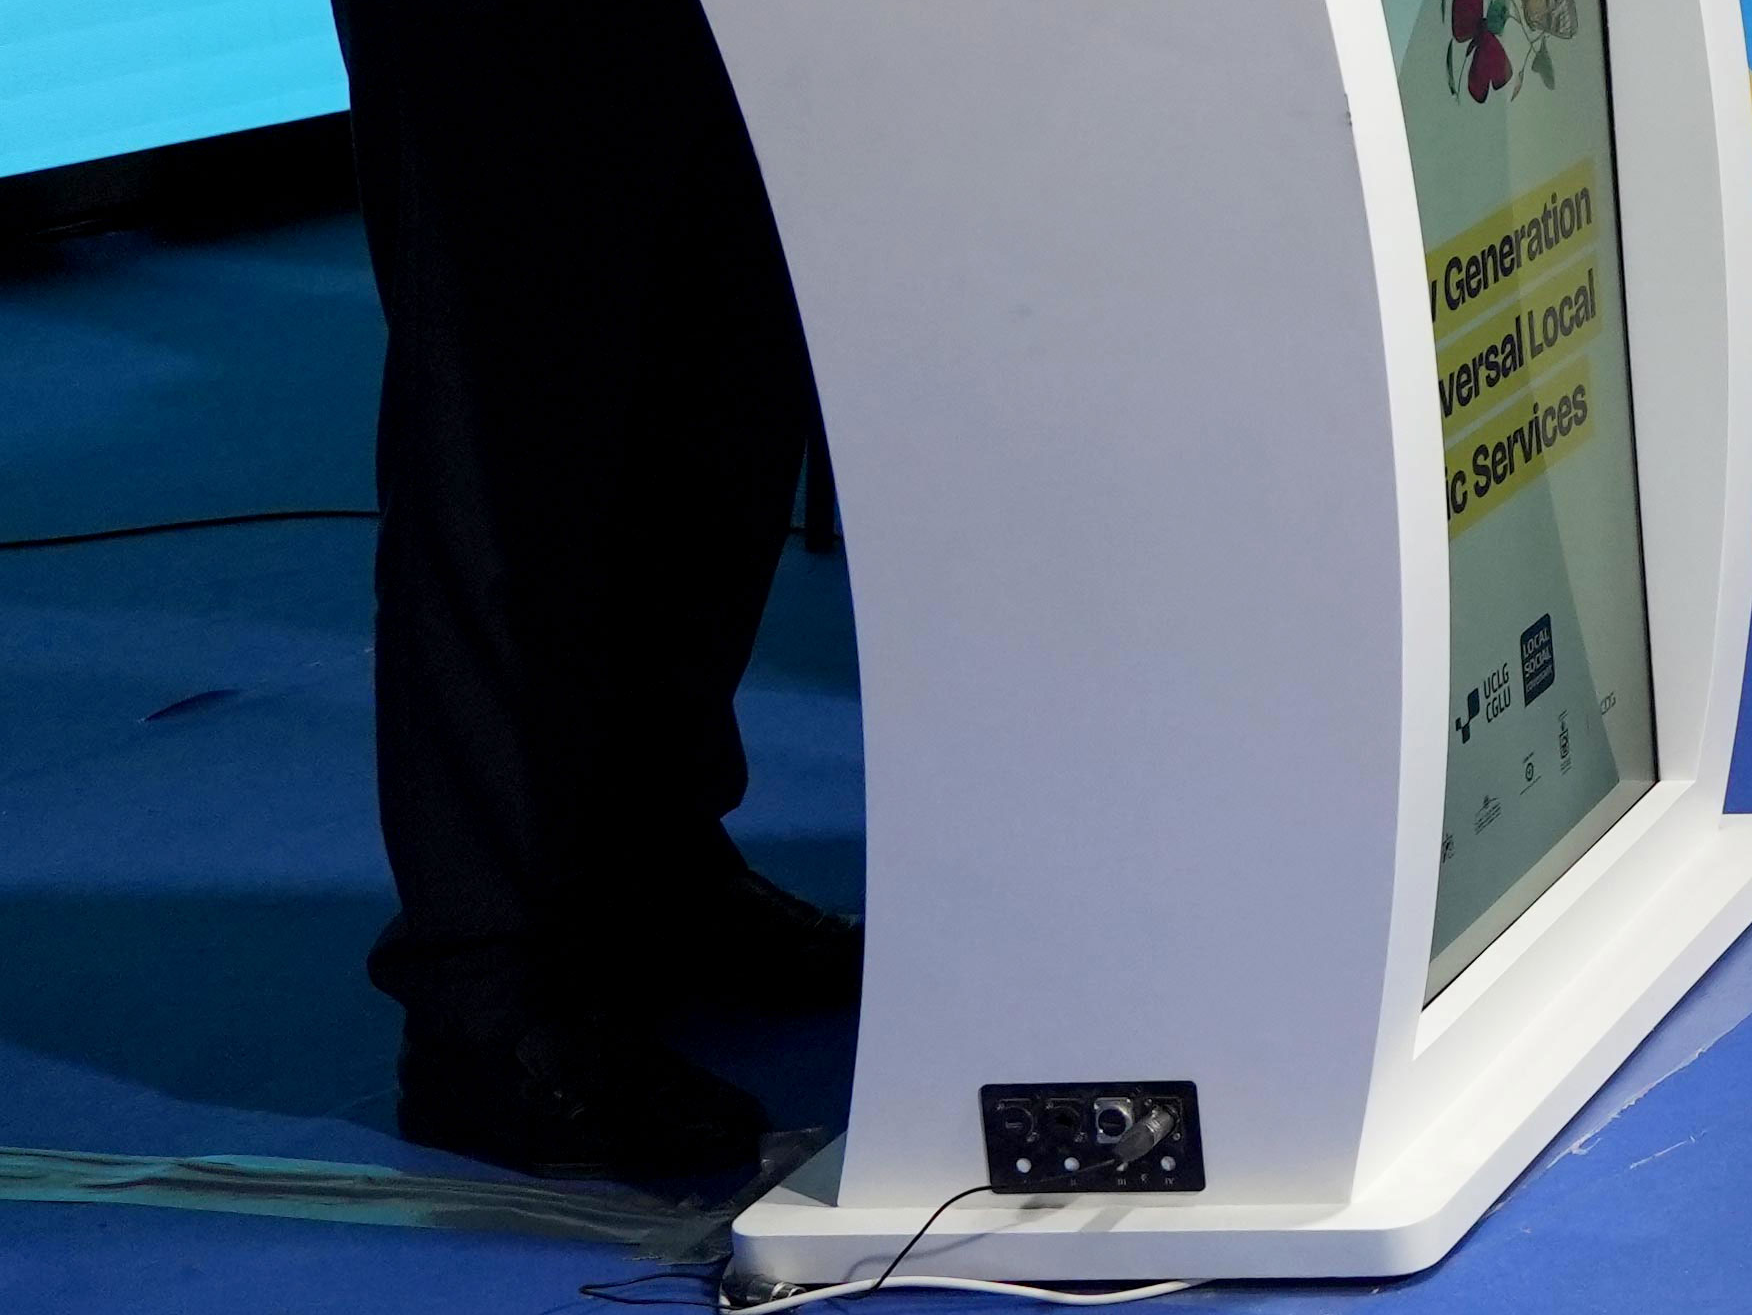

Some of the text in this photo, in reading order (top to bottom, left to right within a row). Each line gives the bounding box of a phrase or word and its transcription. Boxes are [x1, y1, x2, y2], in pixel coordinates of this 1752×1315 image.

[1444, 186, 1593, 312] Generation
[1528, 267, 1597, 361] Local
[1472, 383, 1588, 499] Services
[1521, 627, 1550, 658] LOCAL
[1524, 646, 1552, 677] SOCIAL
[1483, 662, 1510, 700] UCLG
[1486, 685, 1512, 724] CGLU
